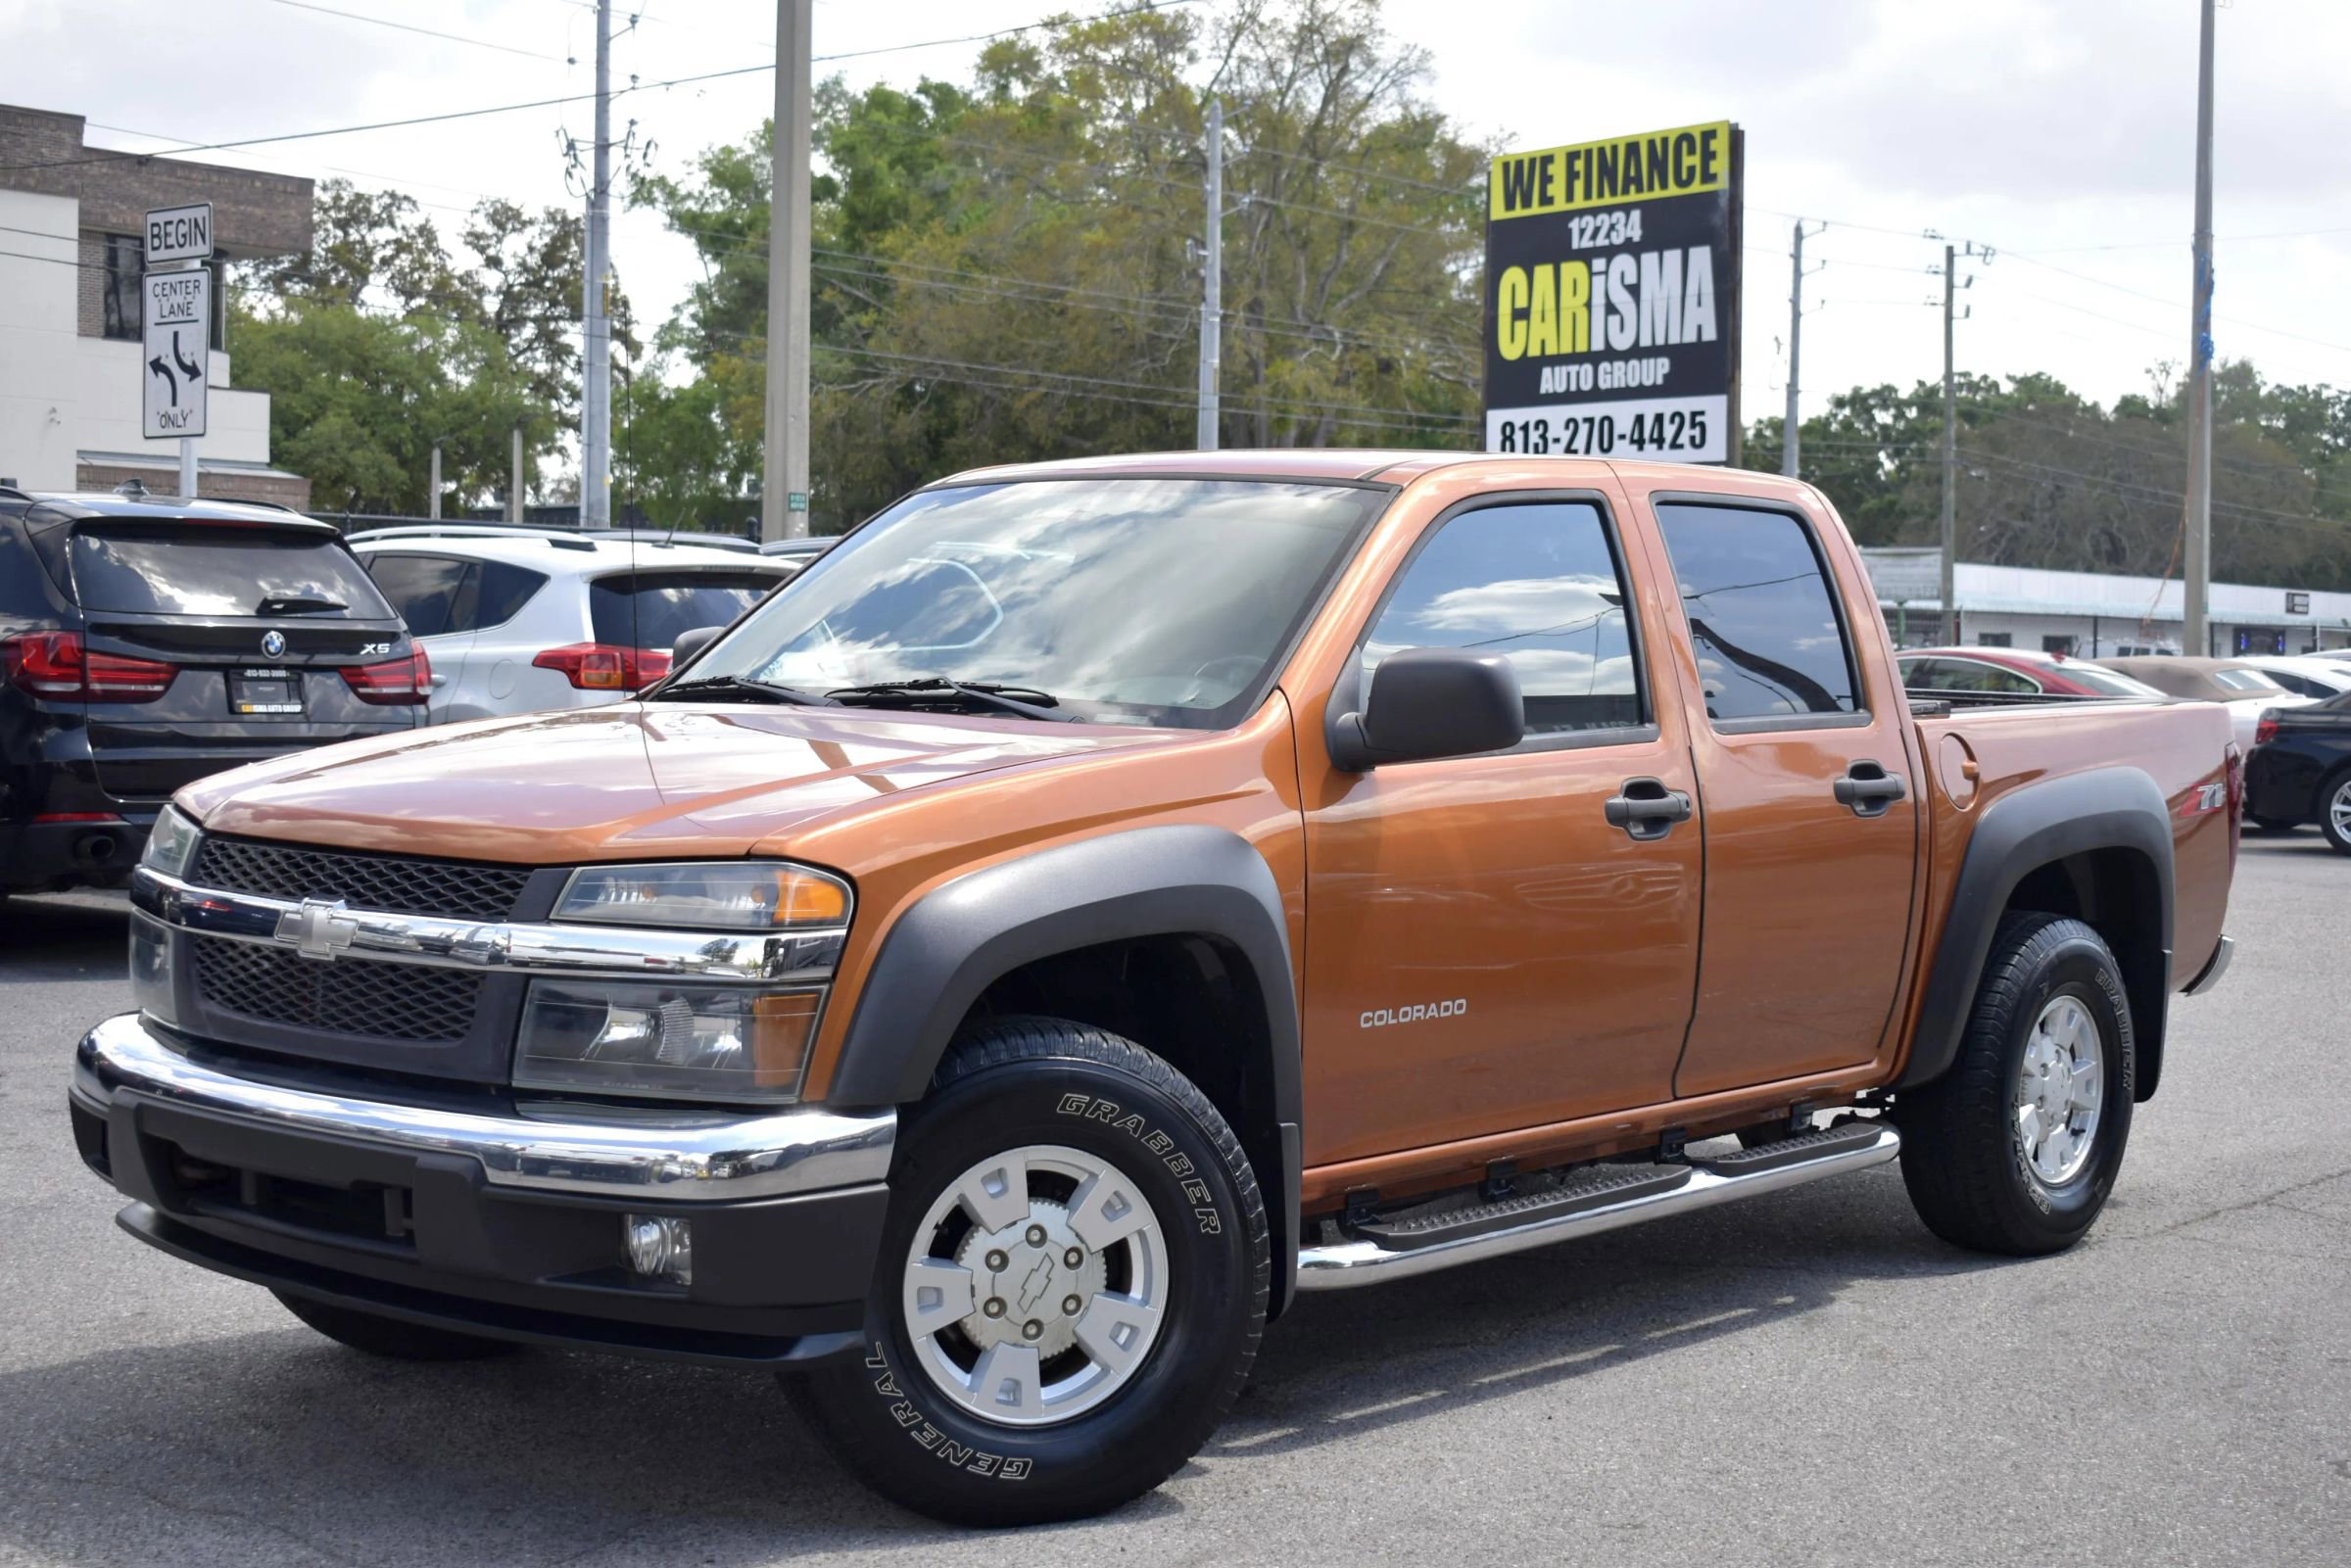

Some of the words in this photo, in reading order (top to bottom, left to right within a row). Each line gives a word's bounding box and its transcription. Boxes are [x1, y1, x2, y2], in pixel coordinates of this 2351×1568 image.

[1502, 154, 1556, 212] WE
[1565, 128, 1718, 204] FINANCE
[150, 215, 207, 252] BEGIN
[1567, 209, 1643, 250] 12234
[153, 279, 202, 299] CENTER
[160, 300, 194, 319] LANE
[1539, 362, 1594, 395] AUTO
[1598, 356, 1671, 390] GROUP
[160, 411, 190, 429] ONLY
[1500, 410, 1707, 454] 813-270-4425
[360, 642, 391, 655] X5
[1360, 998, 1467, 1028] COLORADO
[1057, 1092, 1223, 1234] GRABBER
[865, 1341, 1033, 1480] GENERAL
